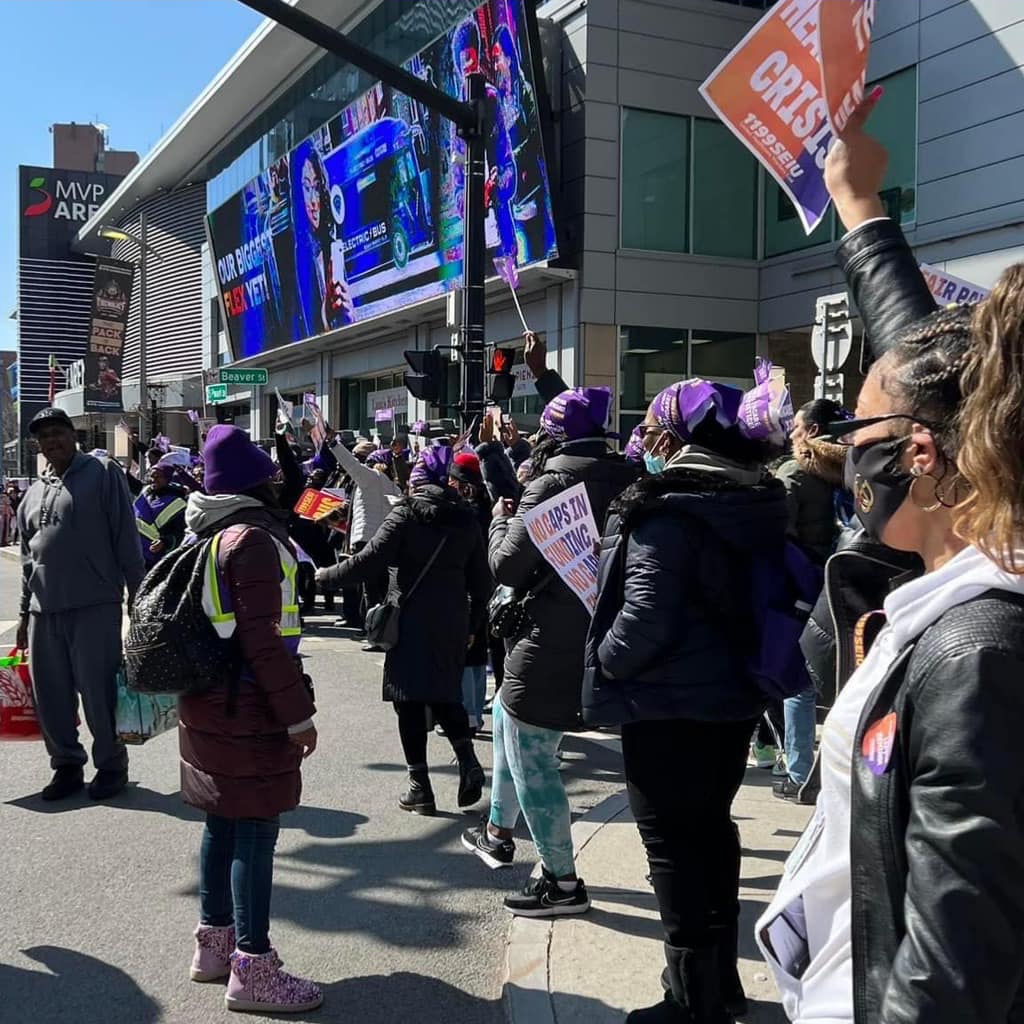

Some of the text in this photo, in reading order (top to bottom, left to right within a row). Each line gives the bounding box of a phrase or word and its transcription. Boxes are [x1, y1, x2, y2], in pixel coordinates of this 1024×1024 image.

[742, 112, 804, 178] 1199SEIU
[56, 180, 104, 201] MVP
[217, 253, 238, 285] OUR
[245, 273, 270, 307] YET!
[92, 327, 122, 339] PACK
[90, 343, 120, 356] BACK
[221, 371, 255, 381] Beaver
[528, 493, 588, 545] NO CAPS IN
[566, 552, 600, 593] NO CAP
